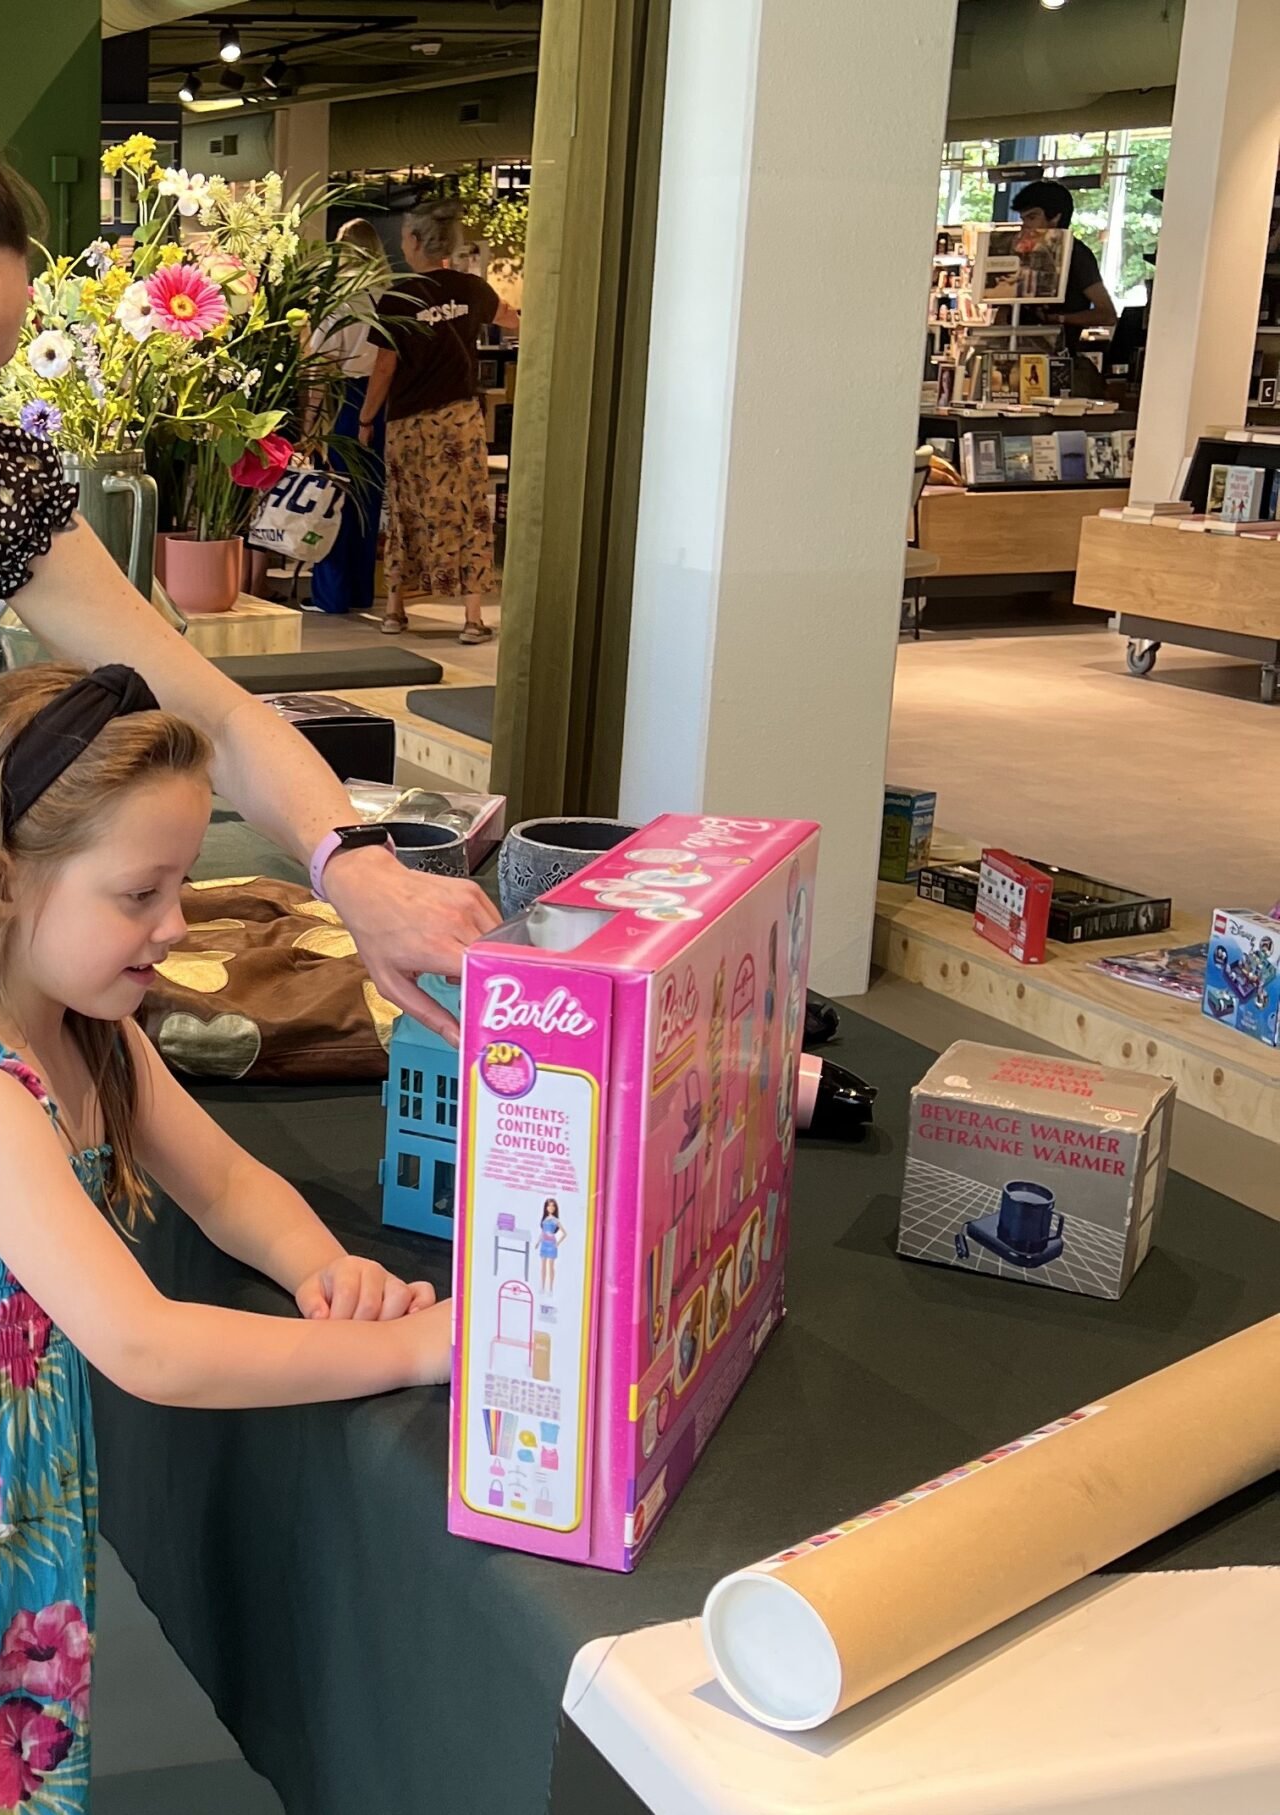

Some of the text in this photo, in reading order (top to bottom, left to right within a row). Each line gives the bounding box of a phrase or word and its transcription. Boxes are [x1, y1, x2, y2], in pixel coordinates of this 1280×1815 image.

[481, 976, 594, 1037] Barbie
[486, 1042, 522, 1065] 20+
[498, 1102, 569, 1125] CONTENTS:
[497, 1117, 561, 1140] CONTIENT
[920, 1102, 1120, 1155] BEVERAGE WARMER
[495, 1132, 570, 1157] CONTEÚDO:
[917, 1123, 1127, 1177] GETRÄNKE WÄRMER
